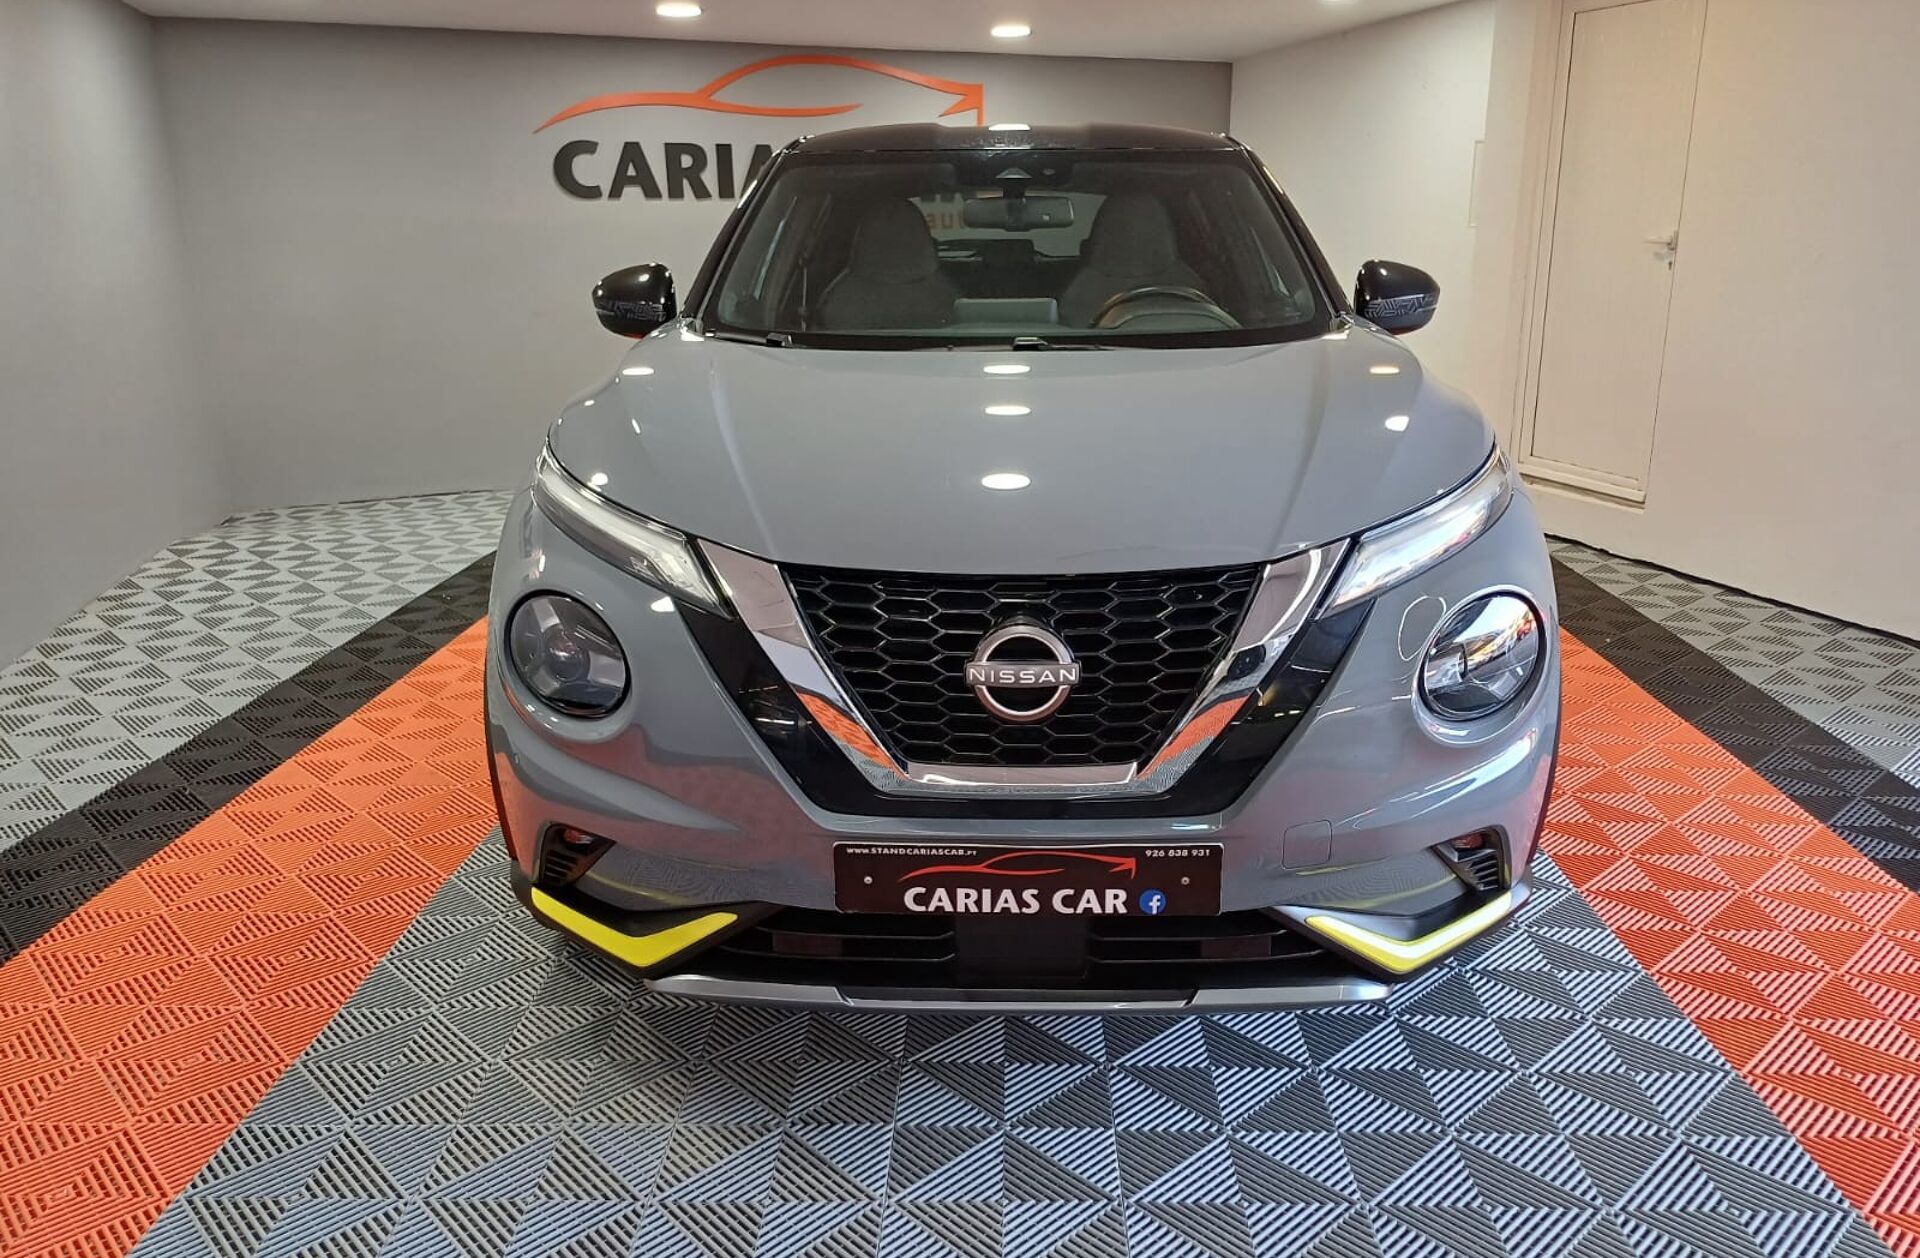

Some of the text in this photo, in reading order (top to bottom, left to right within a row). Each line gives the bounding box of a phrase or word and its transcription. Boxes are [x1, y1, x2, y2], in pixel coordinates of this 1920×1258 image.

[969, 668, 1076, 684] NISSAN
[1145, 849, 1210, 857] 926 838 931
[903, 886, 1128, 914] CARIAS CAR
